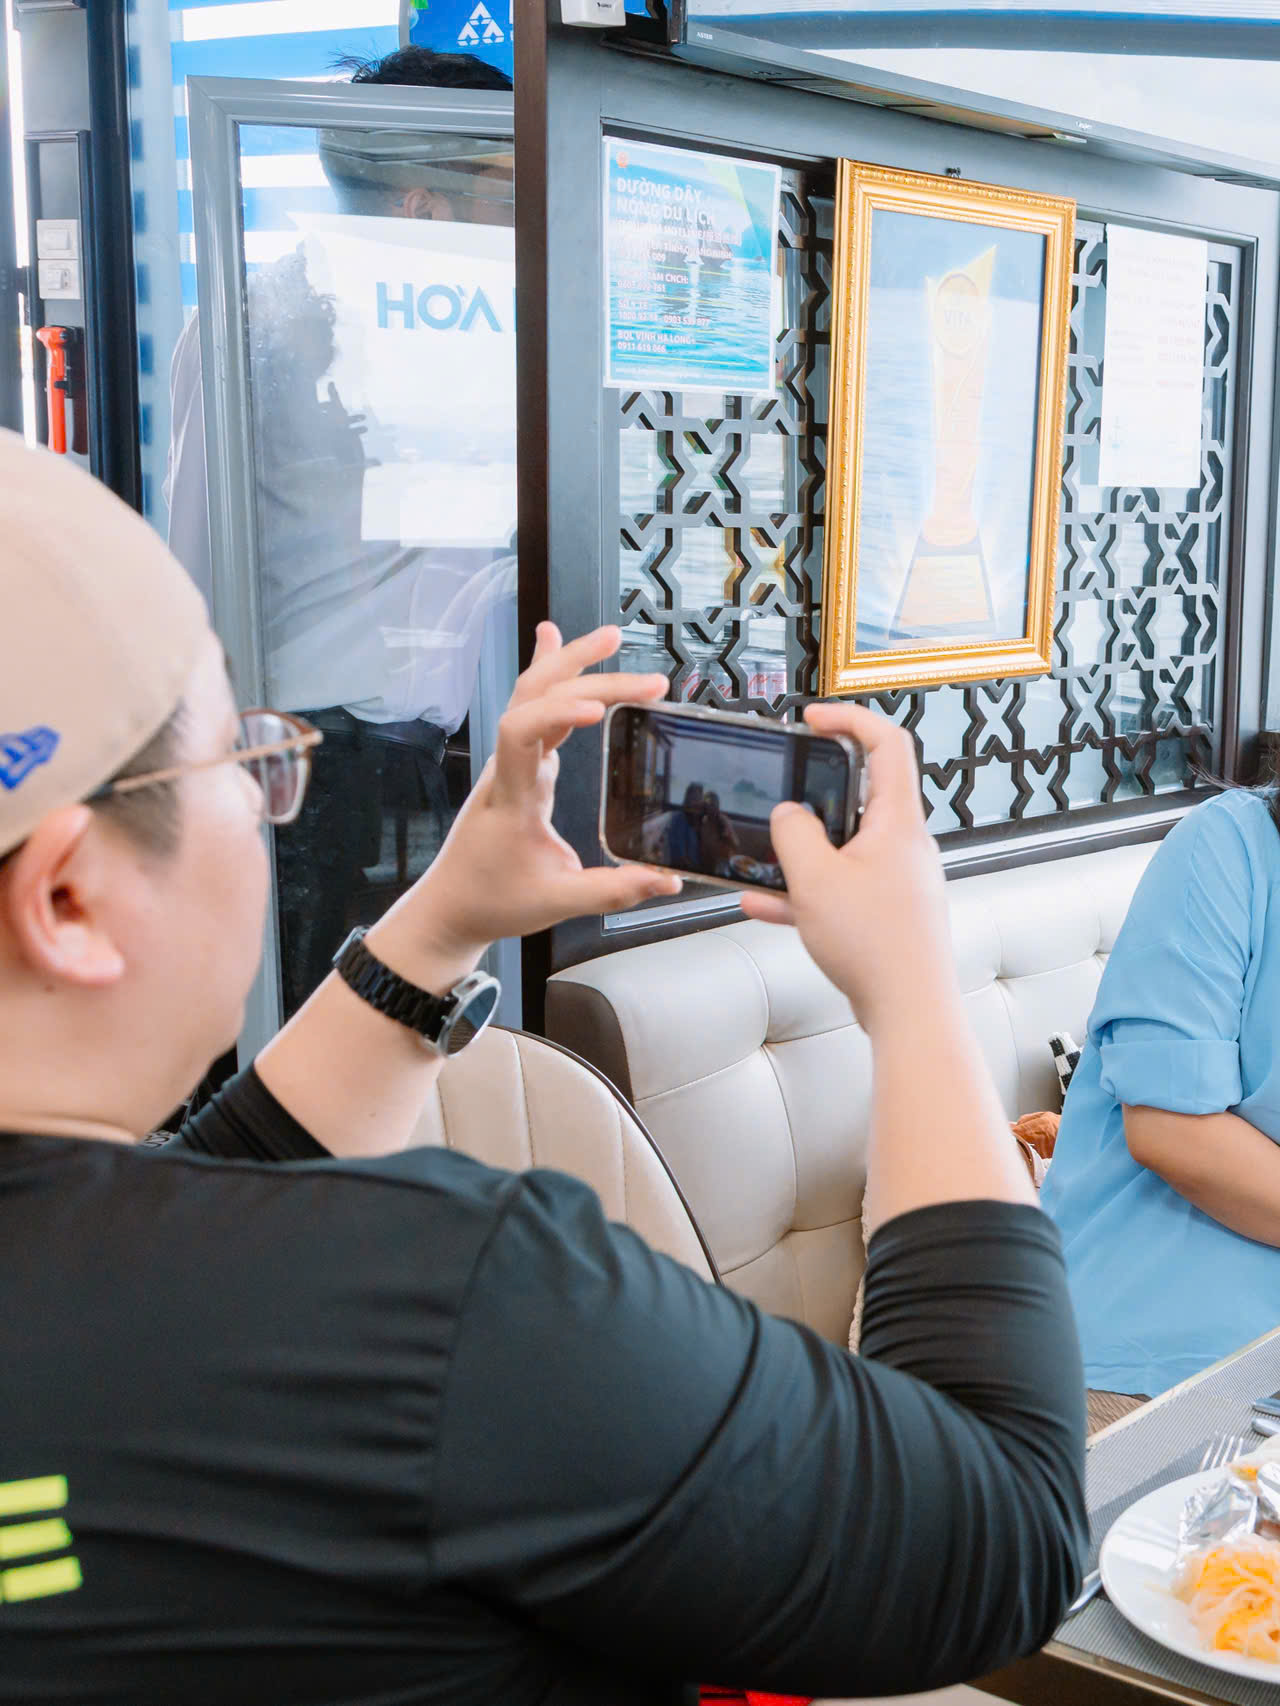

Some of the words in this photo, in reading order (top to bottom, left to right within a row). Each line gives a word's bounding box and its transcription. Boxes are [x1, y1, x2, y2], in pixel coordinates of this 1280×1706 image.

[616, 177, 671, 201] ĐƯỜNG
[673, 184, 703, 203] DÂY
[663, 204, 683, 221] DU
